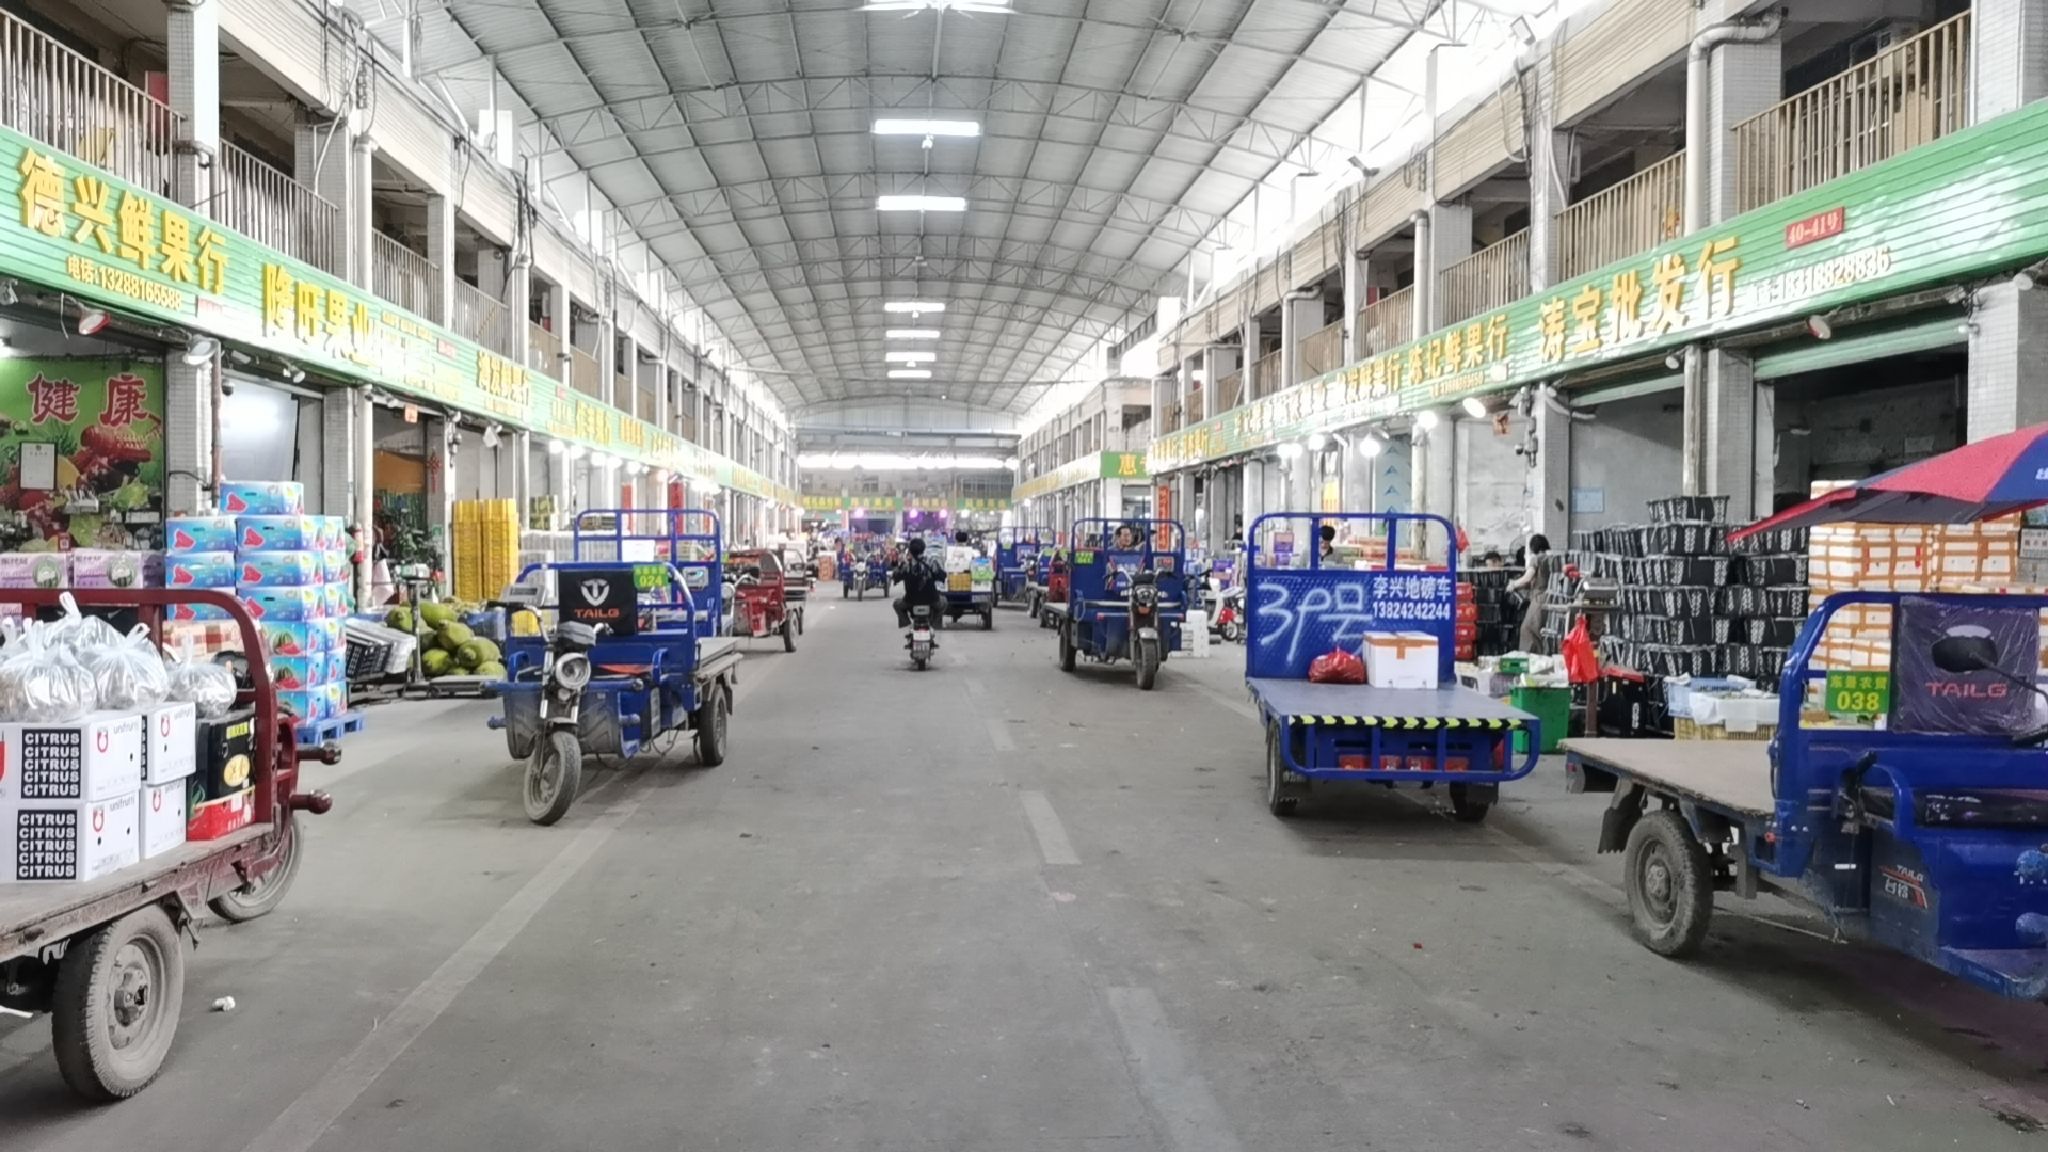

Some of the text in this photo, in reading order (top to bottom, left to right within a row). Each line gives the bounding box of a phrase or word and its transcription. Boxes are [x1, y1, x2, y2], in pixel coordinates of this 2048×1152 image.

[18, 146, 228, 296] 德兴鲜果行
[27, 371, 149, 427] 健康
[1372, 574, 1452, 602] 李兴地磅车
[574, 607, 620, 619] TAILG
[1373, 601, 1451, 620] 13824242244
[1925, 681, 2007, 699] TAILG
[1837, 690, 1880, 711] 038
[25, 733, 80, 744] CITRUS
[24, 746, 80, 757] CITRUS
[24, 759, 80, 770] CITRUS
[24, 771, 79, 783] CITRUS
[23, 784, 79, 796] CITRUS
[19, 814, 76, 826] CITRUS
[19, 828, 75, 838] CITRUS
[19, 840, 75, 851] CITRUS
[19, 852, 75, 864] CITRUS
[18, 865, 75, 878] CITRUS
[1897, 864, 1924, 882] TAILG
